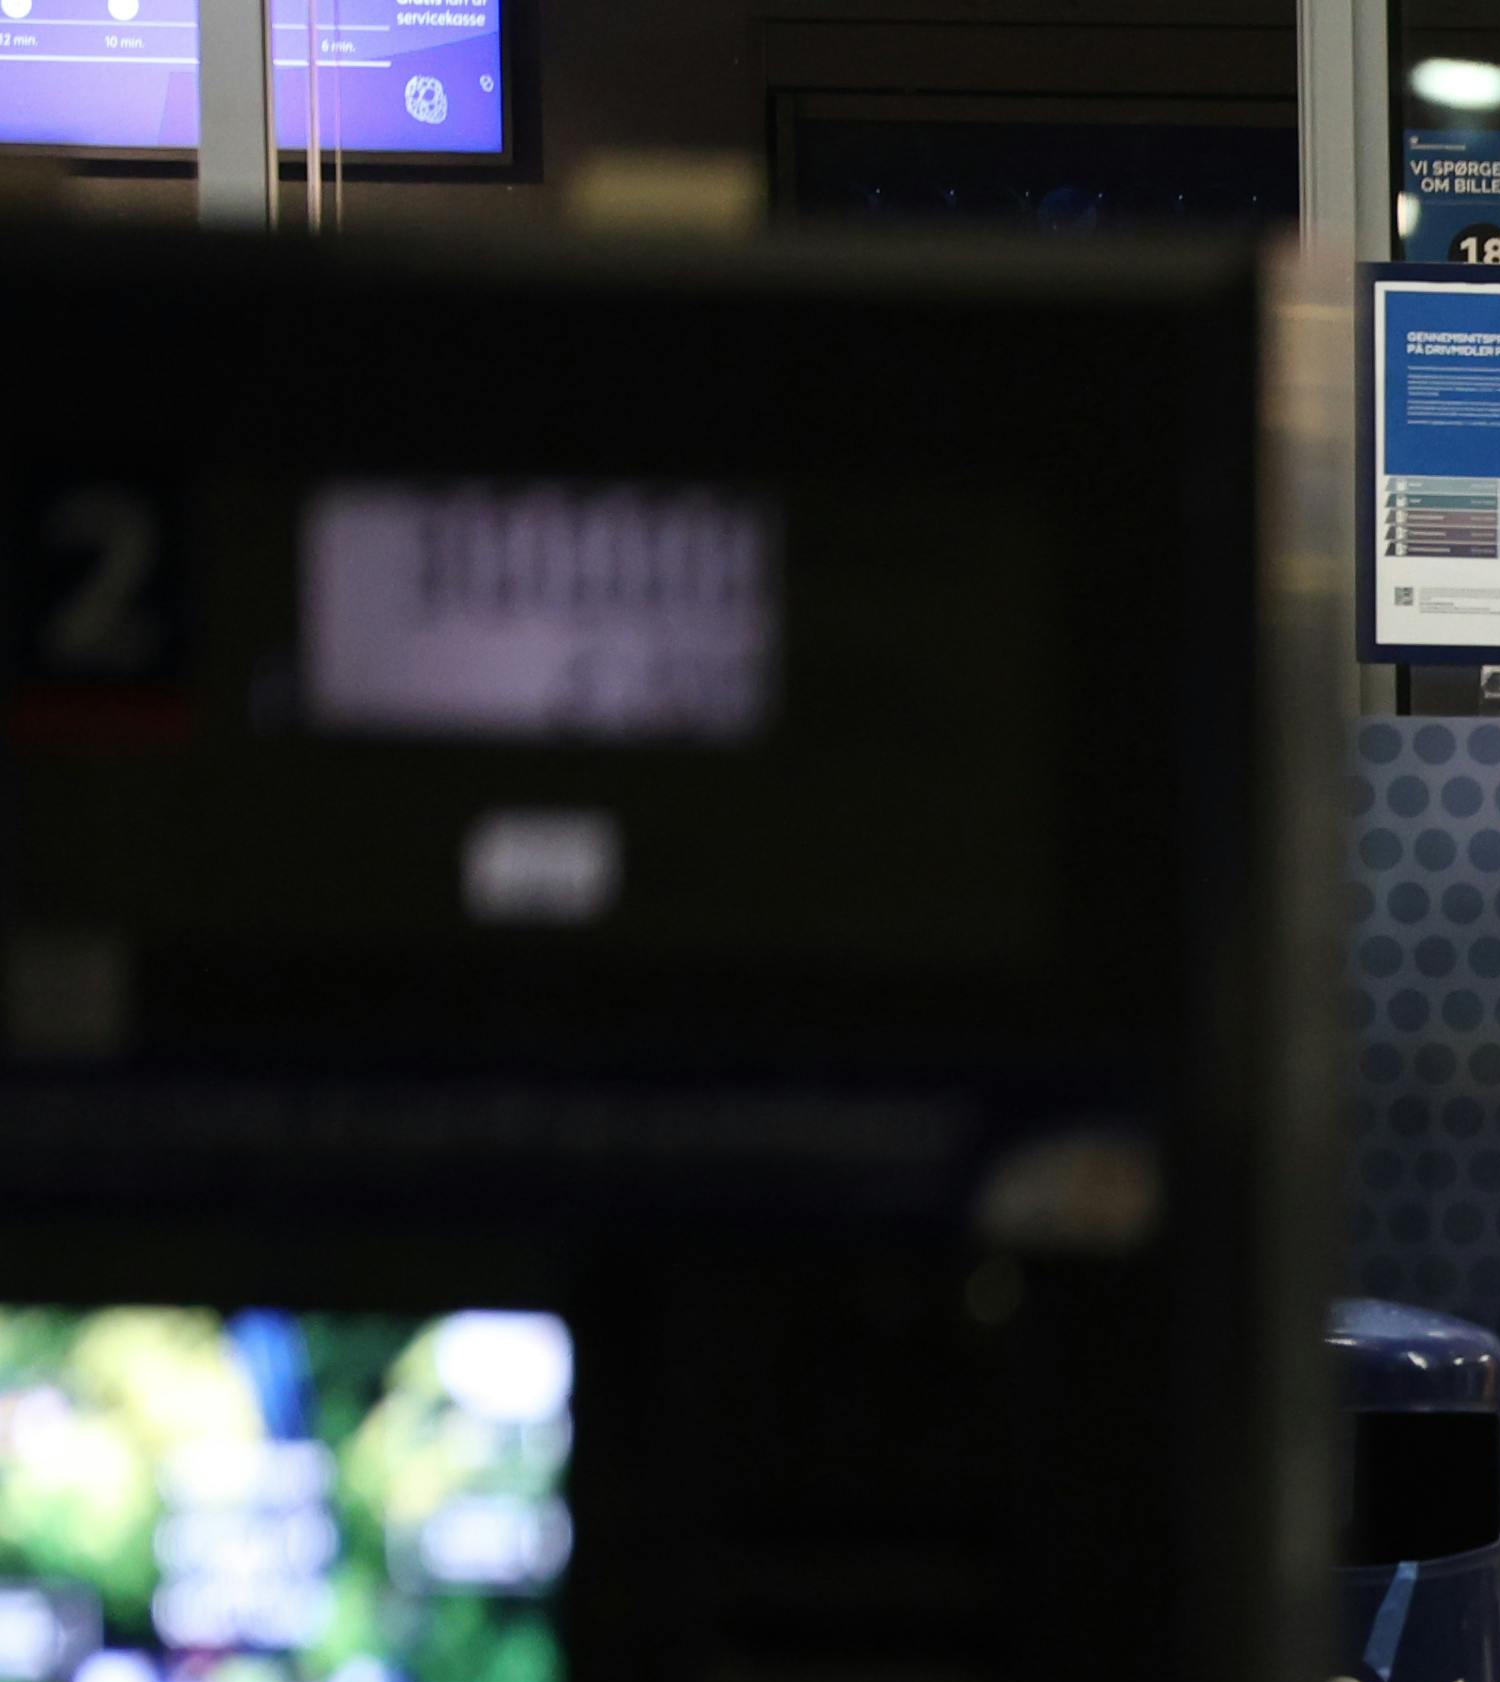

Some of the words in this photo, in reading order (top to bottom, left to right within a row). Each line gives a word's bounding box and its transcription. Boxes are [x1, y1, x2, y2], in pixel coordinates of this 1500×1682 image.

[397, 10, 487, 27] servicekasse
[105, 36, 118, 48] 10
[120, 37, 145, 49] min.
[1410, 160, 1427, 175] VI
[1421, 178, 1449, 193] OM
